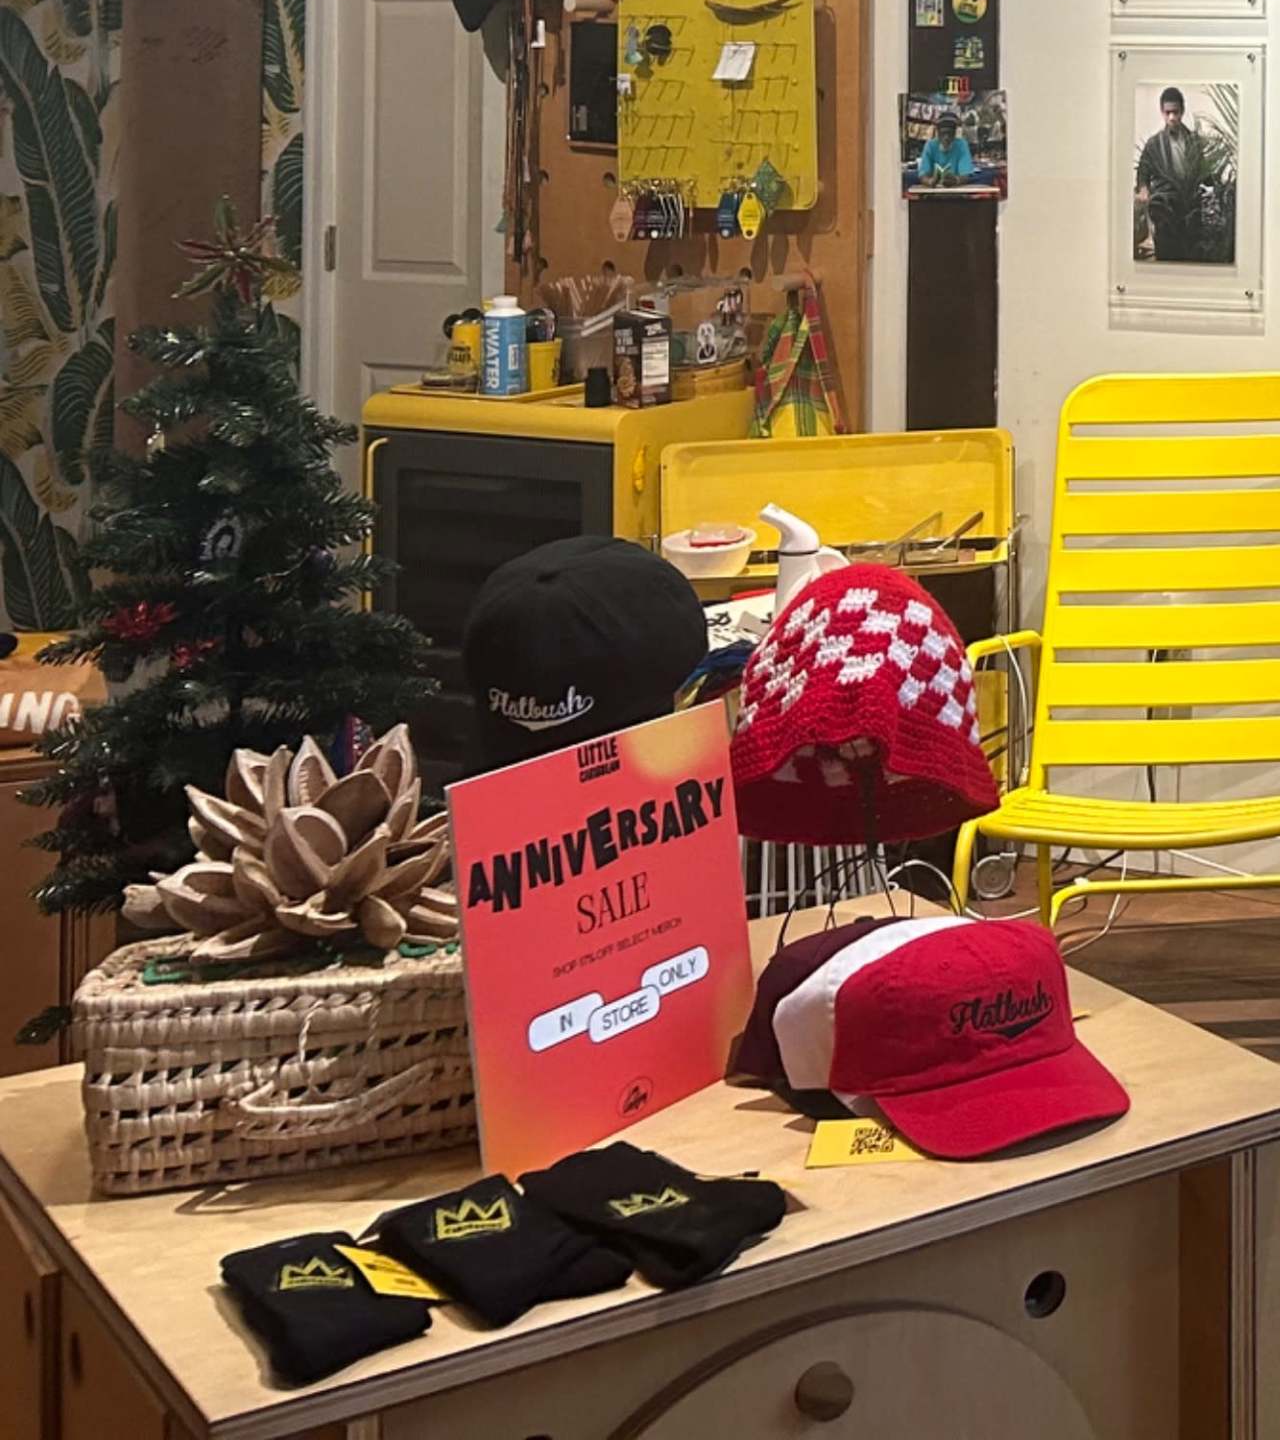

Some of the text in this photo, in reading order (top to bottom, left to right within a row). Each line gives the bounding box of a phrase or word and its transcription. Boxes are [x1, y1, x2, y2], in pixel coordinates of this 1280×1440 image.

[486, 327, 500, 390] WATER
[488, 686, 580, 719] Flatbush
[577, 736, 618, 768] LITTLE
[467, 777, 724, 913] ANNIVERSARY
[576, 871, 650, 935] SALE
[559, 956, 697, 1033] IN STORE ONLY
[950, 980, 1050, 1035] Flatbush
